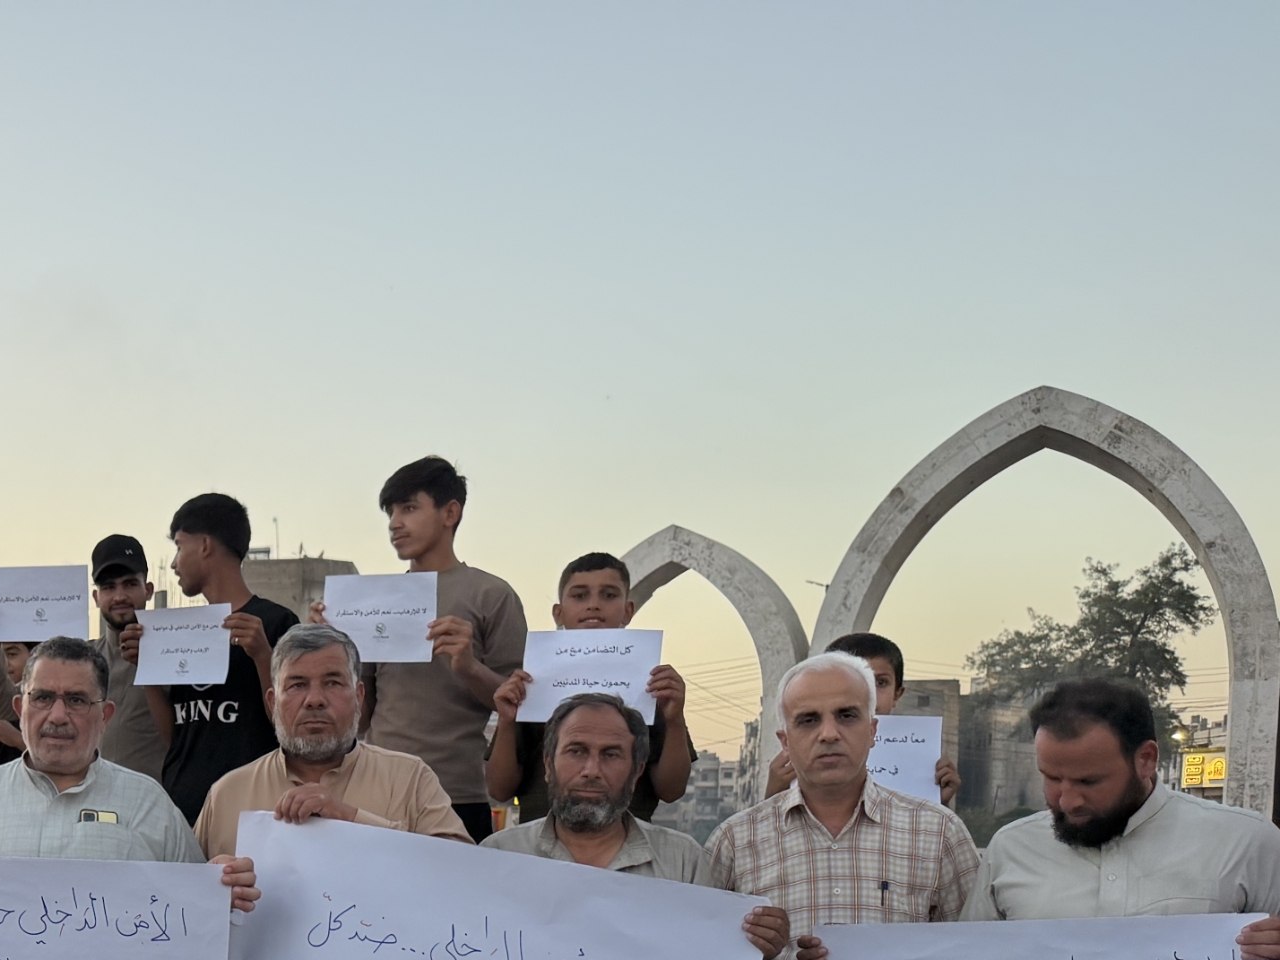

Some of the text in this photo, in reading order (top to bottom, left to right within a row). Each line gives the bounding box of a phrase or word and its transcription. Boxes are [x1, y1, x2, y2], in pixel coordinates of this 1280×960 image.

[570, 647, 582, 656] مع
[584, 645, 618, 654] التضامن
[620, 645, 634, 655] كل
[552, 679, 630, 689] يحمون حياة المدنيين
[174, 700, 239, 725] KING
[884, 735, 908, 744] لدعم
[889, 765, 898, 776] في
